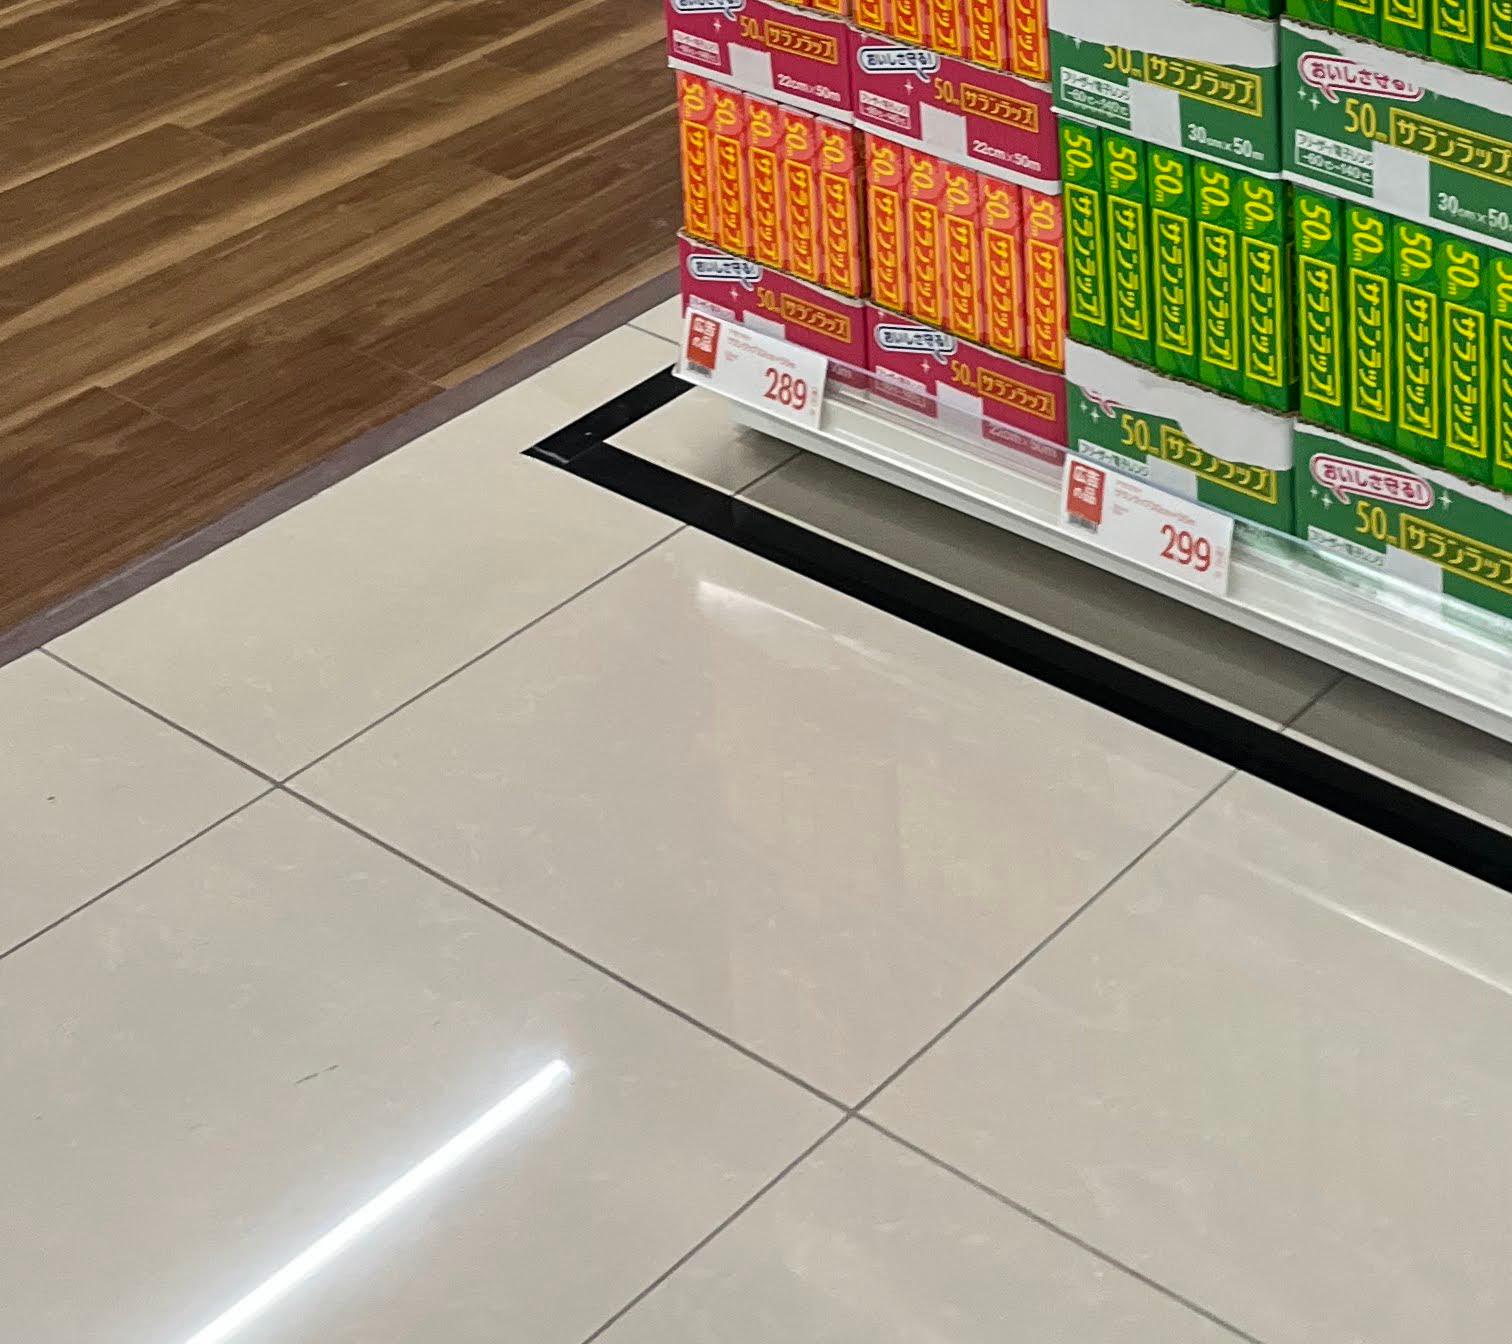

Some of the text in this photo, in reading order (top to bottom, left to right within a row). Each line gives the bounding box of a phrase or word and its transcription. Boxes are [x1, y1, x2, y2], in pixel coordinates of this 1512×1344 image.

[1149, 56, 1255, 105] サランラップ
[763, 367, 809, 410] 289
[1323, 464, 1426, 500] おいしさ守る!
[1160, 523, 1212, 573] 299
